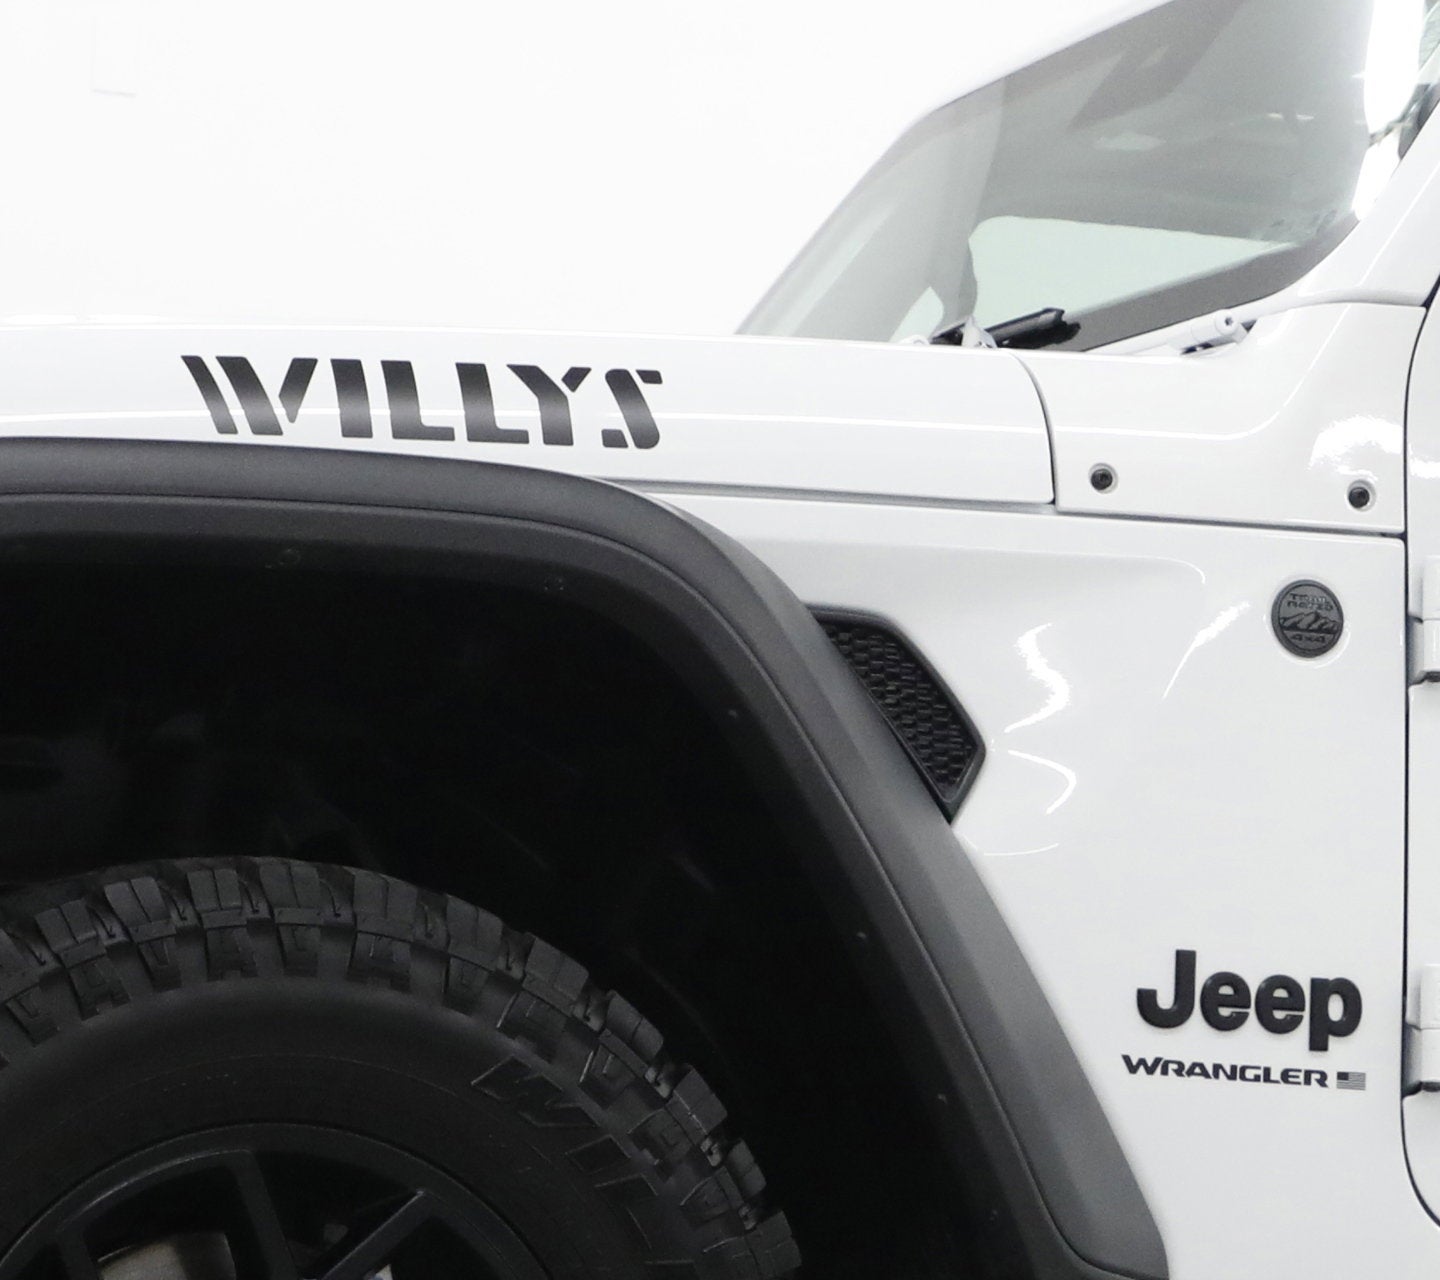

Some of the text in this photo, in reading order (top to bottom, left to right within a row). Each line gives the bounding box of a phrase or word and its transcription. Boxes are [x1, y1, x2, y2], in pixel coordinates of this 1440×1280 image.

[181, 355, 663, 449] WILLYS
[1136, 949, 1363, 1051] Jeep
[1121, 1054, 1329, 1088] WRANGLER
